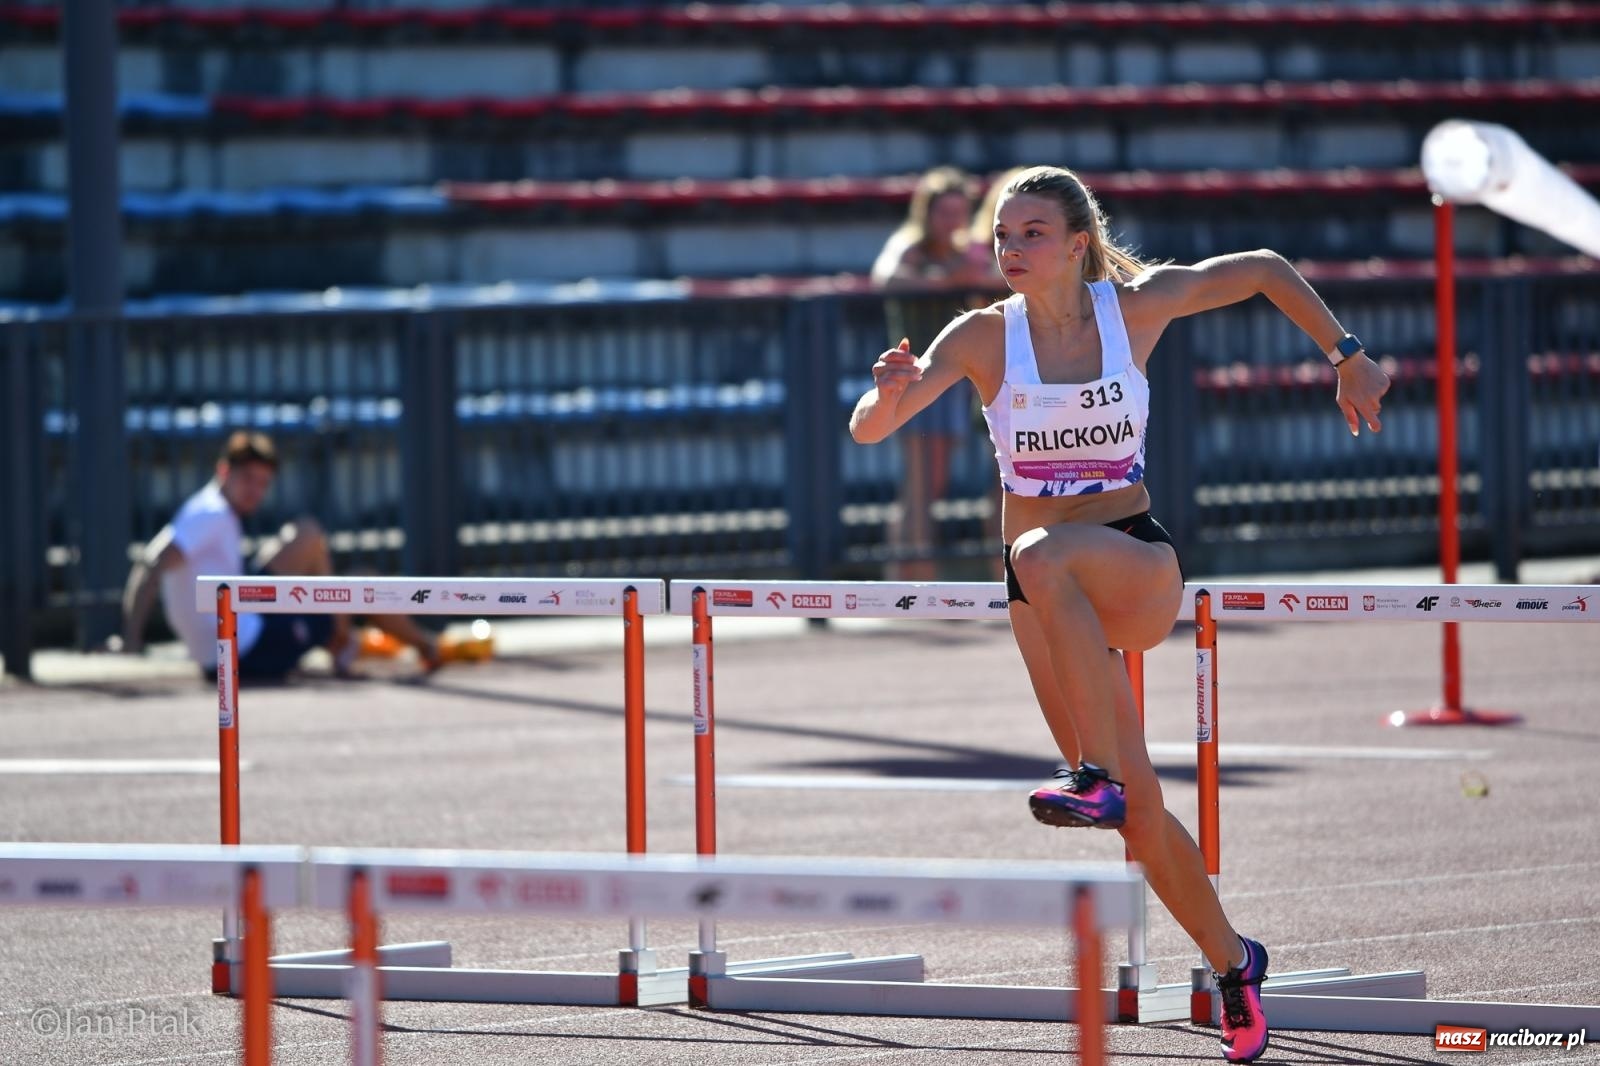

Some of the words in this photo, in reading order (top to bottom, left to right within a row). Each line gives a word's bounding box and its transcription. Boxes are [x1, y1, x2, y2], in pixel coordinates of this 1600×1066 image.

[1080, 381, 1123, 409] 313
[1015, 413, 1134, 453] FRLICKOVÁ
[315, 590, 349, 602] ORLEN
[410, 589, 432, 603] 4F
[794, 595, 830, 608] ORLEN
[895, 595, 917, 610] 4F
[1308, 598, 1346, 609] ORLEN
[1416, 596, 1440, 611] 4F
